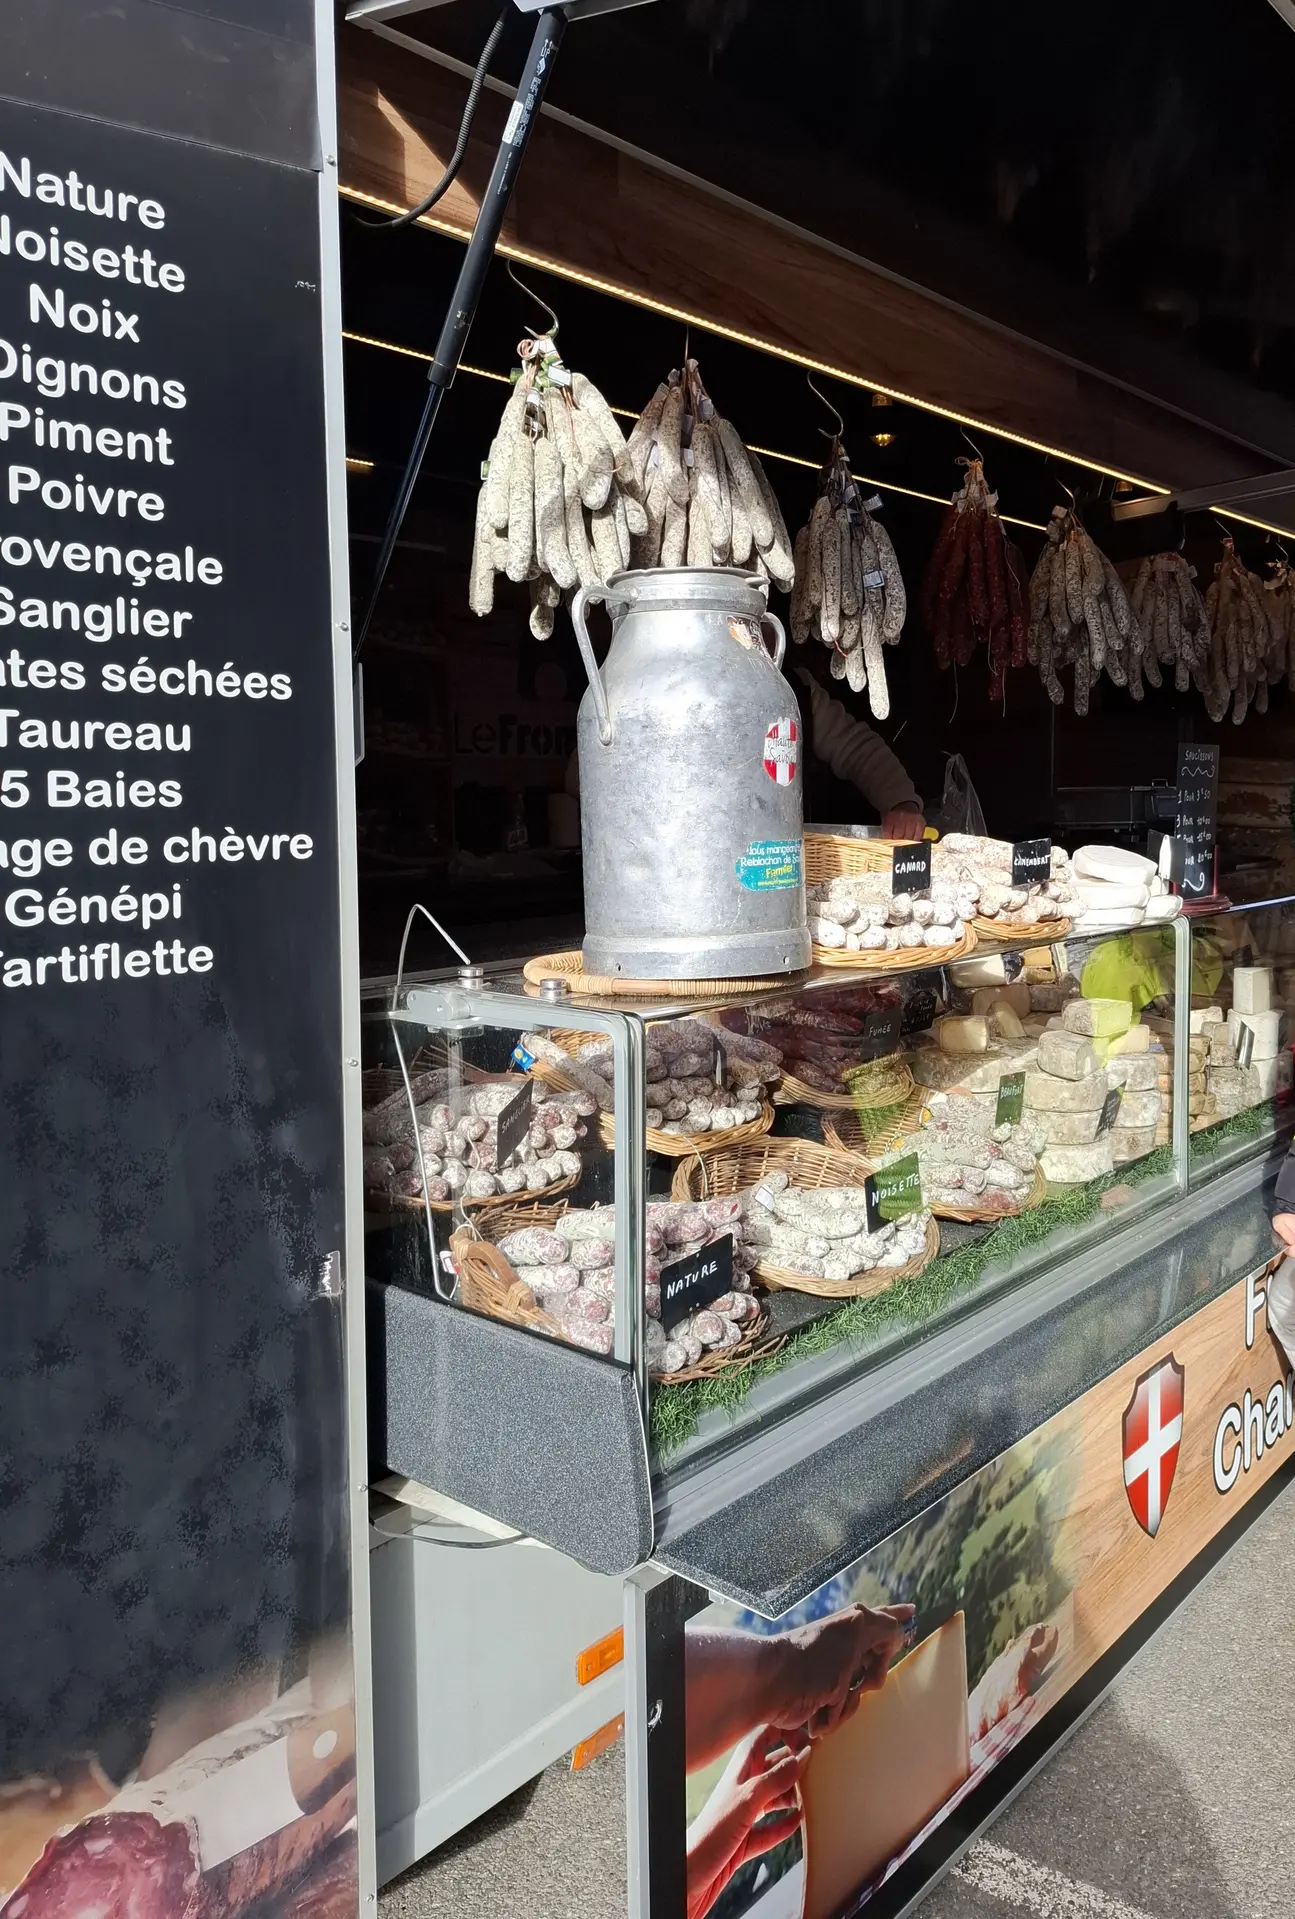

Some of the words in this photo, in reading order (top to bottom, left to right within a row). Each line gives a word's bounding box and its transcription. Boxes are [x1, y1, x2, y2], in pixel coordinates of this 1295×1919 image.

[0, 150, 165, 230] Nature
[0, 214, 186, 293] oisette
[29, 282, 140, 343] Noix
[0, 401, 174, 466] Piment
[8, 464, 165, 522] Poivre
[0, 535, 224, 587] ovençale
[0, 648, 87, 691] tes
[101, 656, 293, 701] séchées
[0, 708, 191, 752] Taureau
[0, 769, 30, 809] 5
[47, 769, 183, 809] Baies
[1177, 789, 1182, 804] 1
[1176, 814, 1181, 828] 3
[88, 827, 149, 866] de
[163, 825, 314, 864] chèvre
[740, 856, 782, 867] Reblochon
[894, 861, 926, 873] CANARD
[1013, 852, 1051, 867] CAMEMBERT
[4, 884, 182, 930] Génépi
[0, 938, 215, 988] artiflette
[666, 1259, 718, 1300] NATURE
